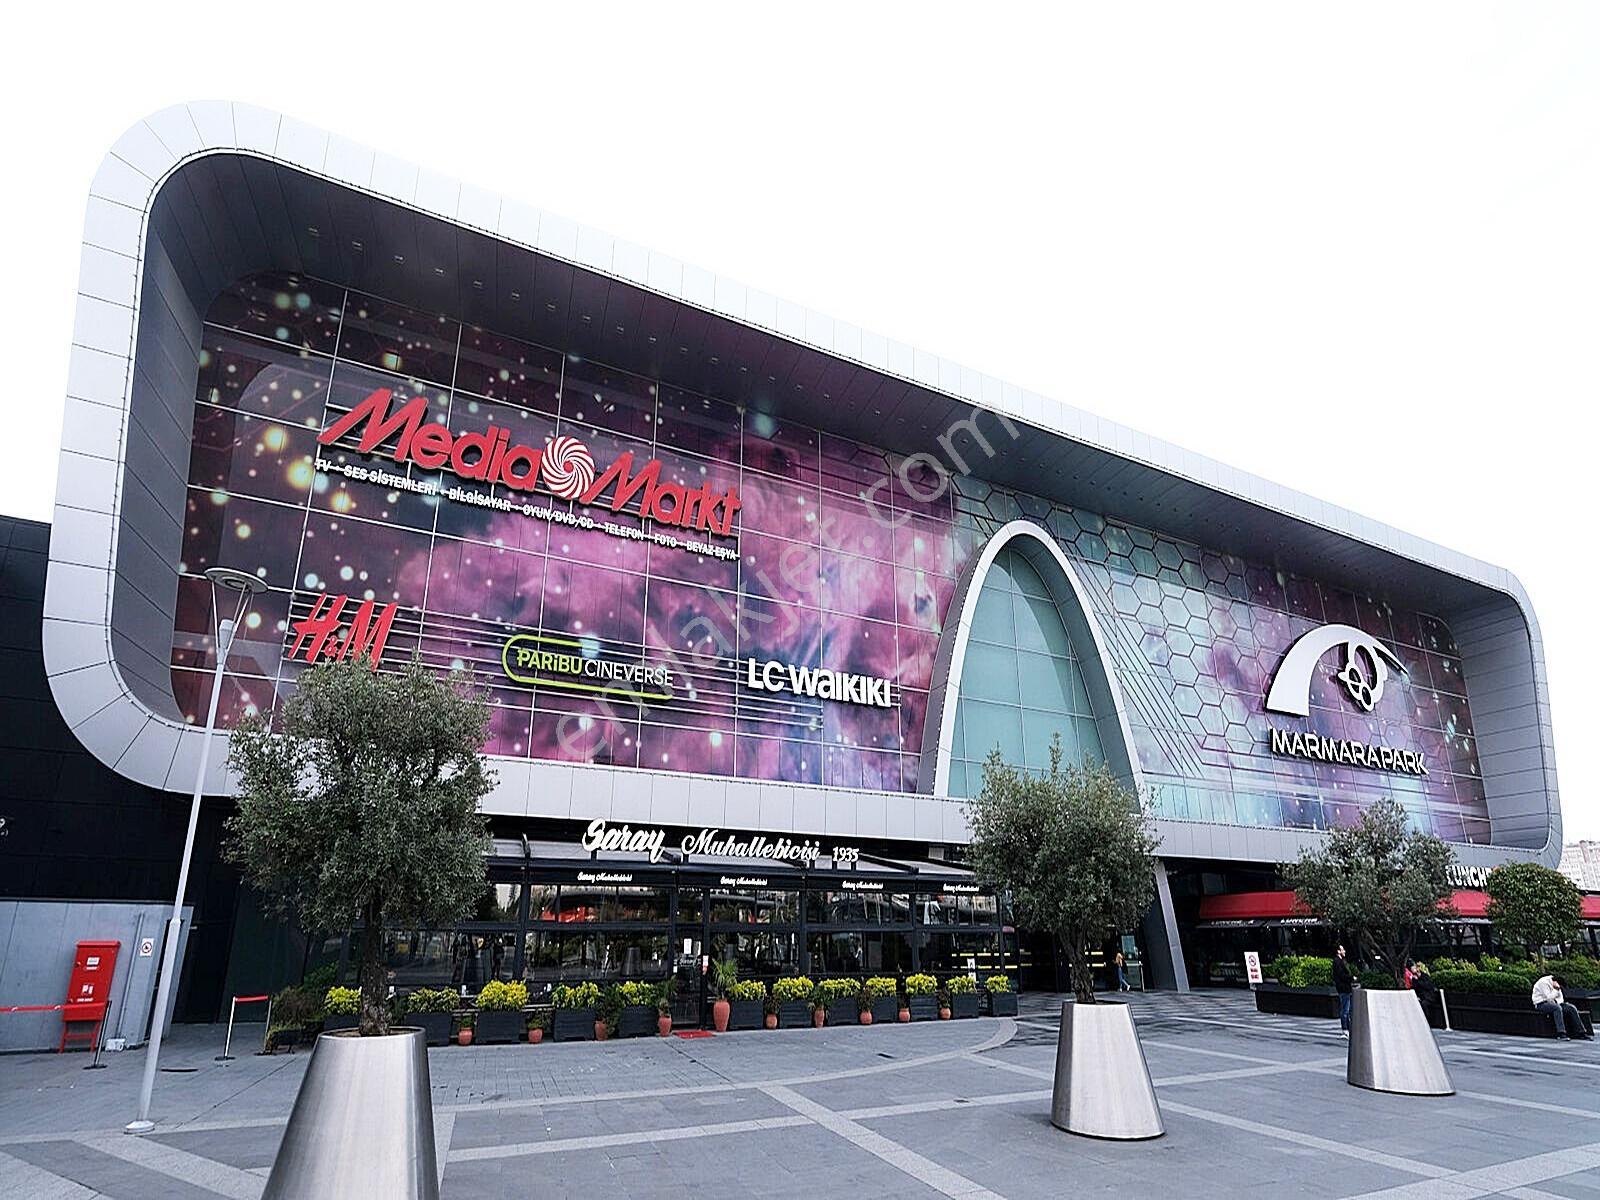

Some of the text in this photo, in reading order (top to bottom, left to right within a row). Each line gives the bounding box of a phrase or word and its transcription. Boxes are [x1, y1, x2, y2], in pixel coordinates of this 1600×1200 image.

[316, 387, 742, 536] Media Markt
[316, 459, 331, 472] TV
[344, 465, 367, 480] SES
[604, 521, 645, 541] TELEFON
[654, 533, 678, 548] FOTO
[686, 540, 714, 556] BEYAZ
[715, 546, 737, 561] EŞYA
[288, 592, 398, 673] H&M
[584, 659, 674, 687] CINEVERSE
[748, 657, 785, 692] LC
[581, 817, 860, 864] Saray Muhallebicisi 1935
[1445, 865, 1492, 888] LUNCH
